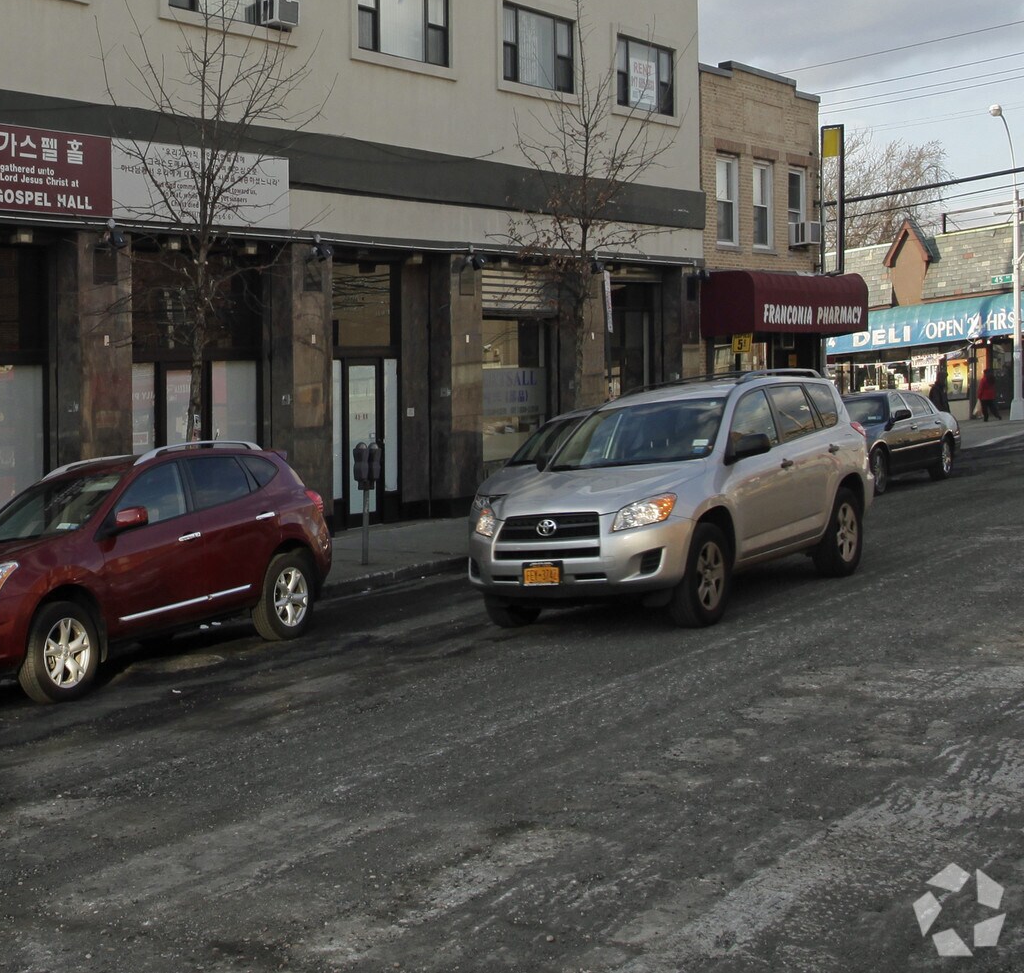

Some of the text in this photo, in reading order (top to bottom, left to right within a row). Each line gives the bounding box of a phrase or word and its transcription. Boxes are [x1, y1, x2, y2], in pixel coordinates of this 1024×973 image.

[66, 139, 84, 165] 홀
[0, 164, 35, 176] gathered
[37, 166, 55, 176] unto
[0, 172, 18, 182] Lord
[20, 174, 43, 185] Jesus
[46, 176, 68, 187] Christ
[71, 179, 79, 188] at
[57, 194, 92, 210] HALL
[763, 303, 862, 325] FRANCONIA PHARMACY
[925, 318, 963, 339] OPEN
[986, 311, 1015, 331] HRS
[852, 325, 911, 347] DELI
